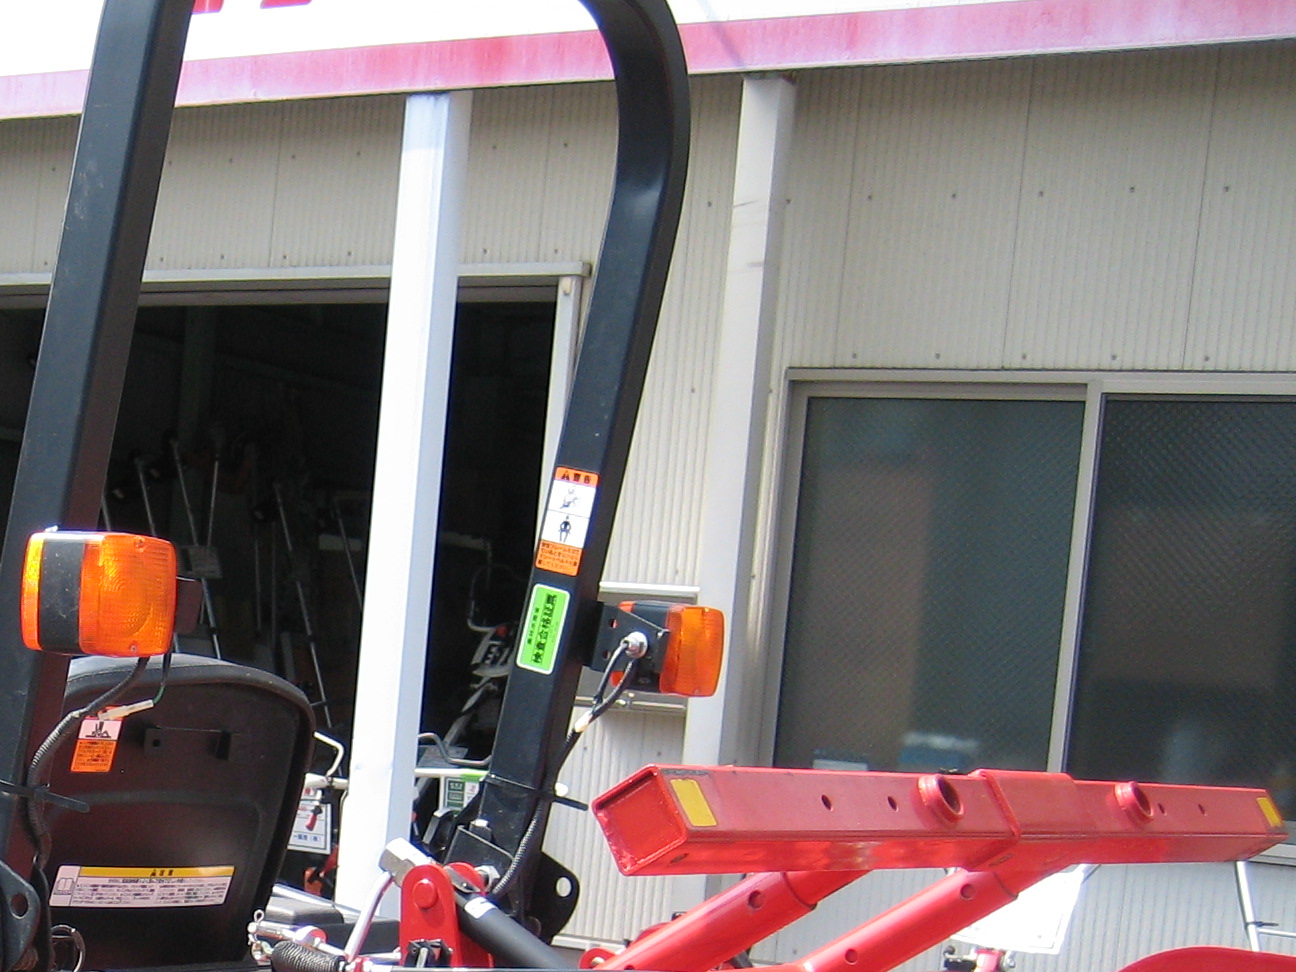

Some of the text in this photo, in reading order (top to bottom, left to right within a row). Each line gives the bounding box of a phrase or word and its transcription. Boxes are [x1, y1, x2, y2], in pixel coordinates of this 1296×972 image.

[532, 594, 557, 664] 検査合格証票
